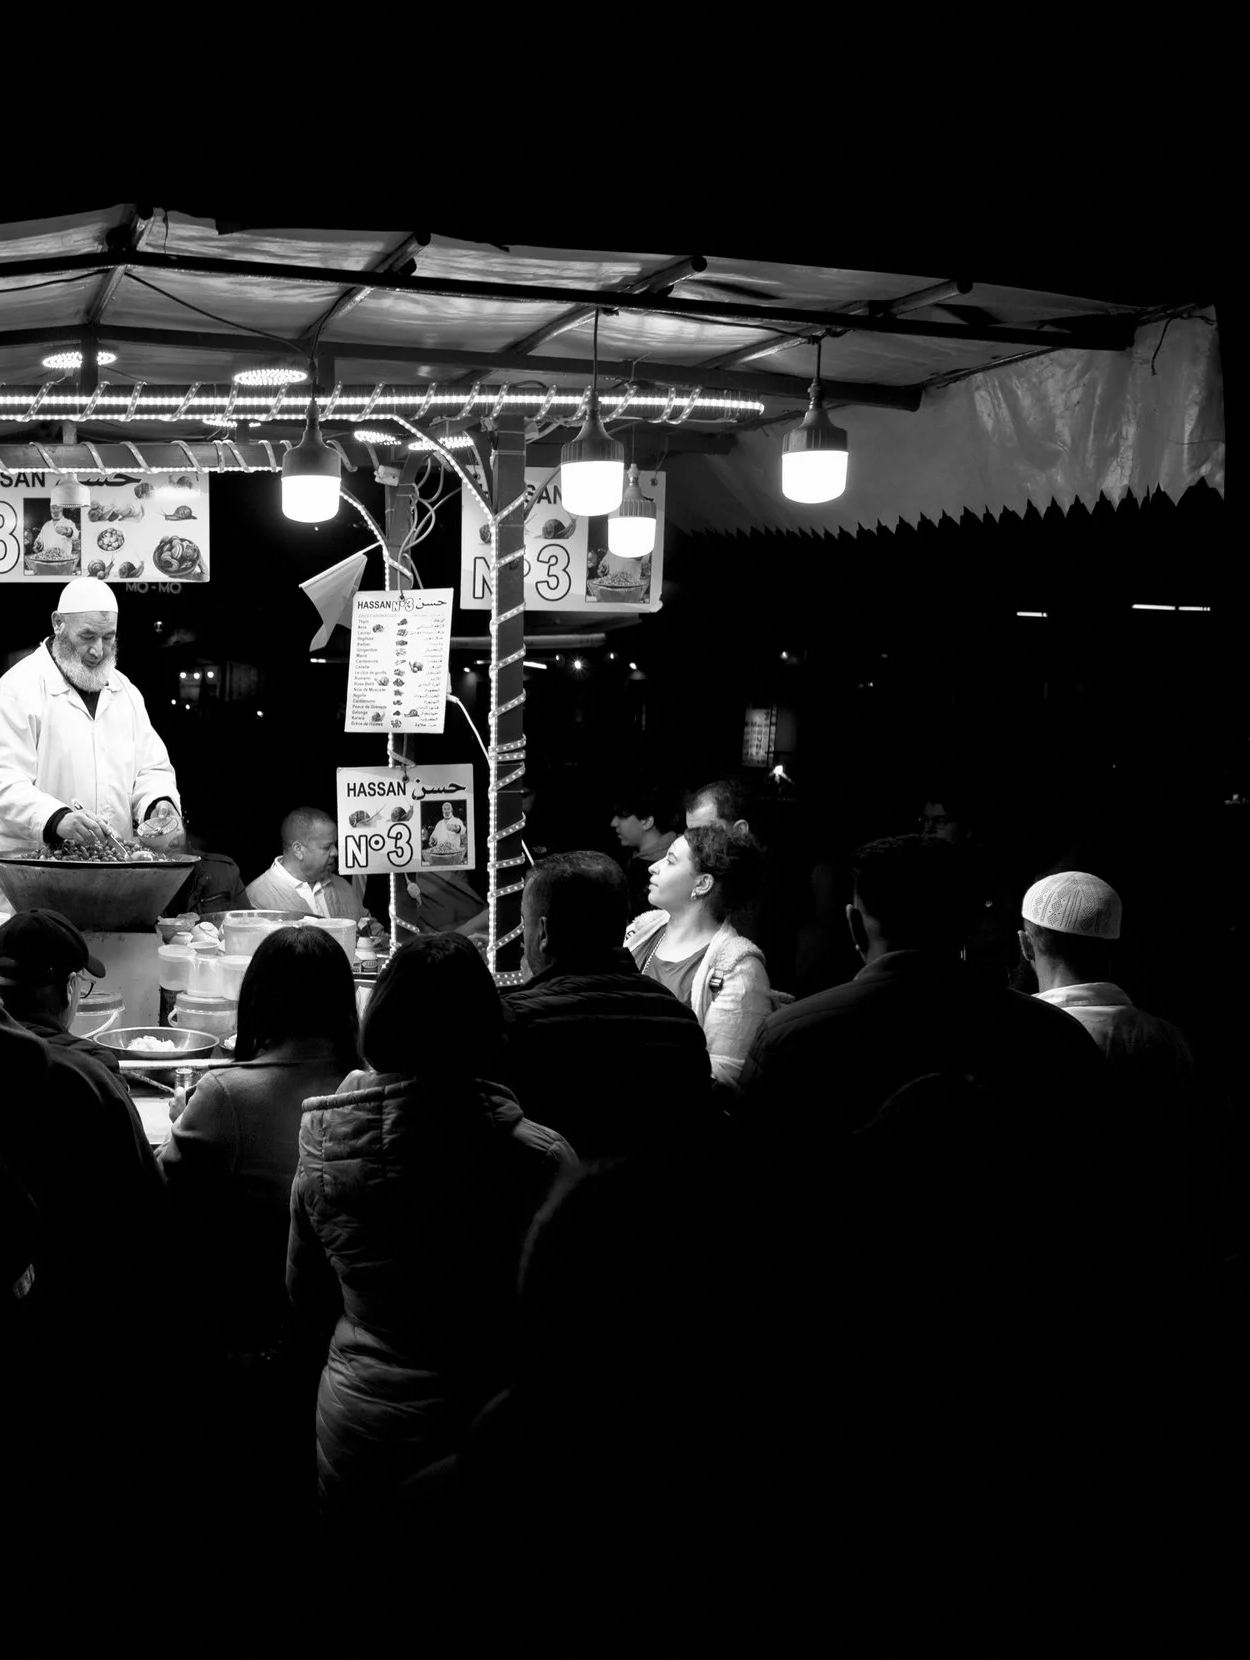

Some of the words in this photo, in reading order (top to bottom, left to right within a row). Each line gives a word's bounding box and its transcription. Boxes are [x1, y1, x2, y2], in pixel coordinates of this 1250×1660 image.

[357, 600, 391, 609] HASSAN
[416, 597, 447, 610] حسن
[347, 781, 406, 797] HASSAN
[411, 778, 466, 800] حسن
